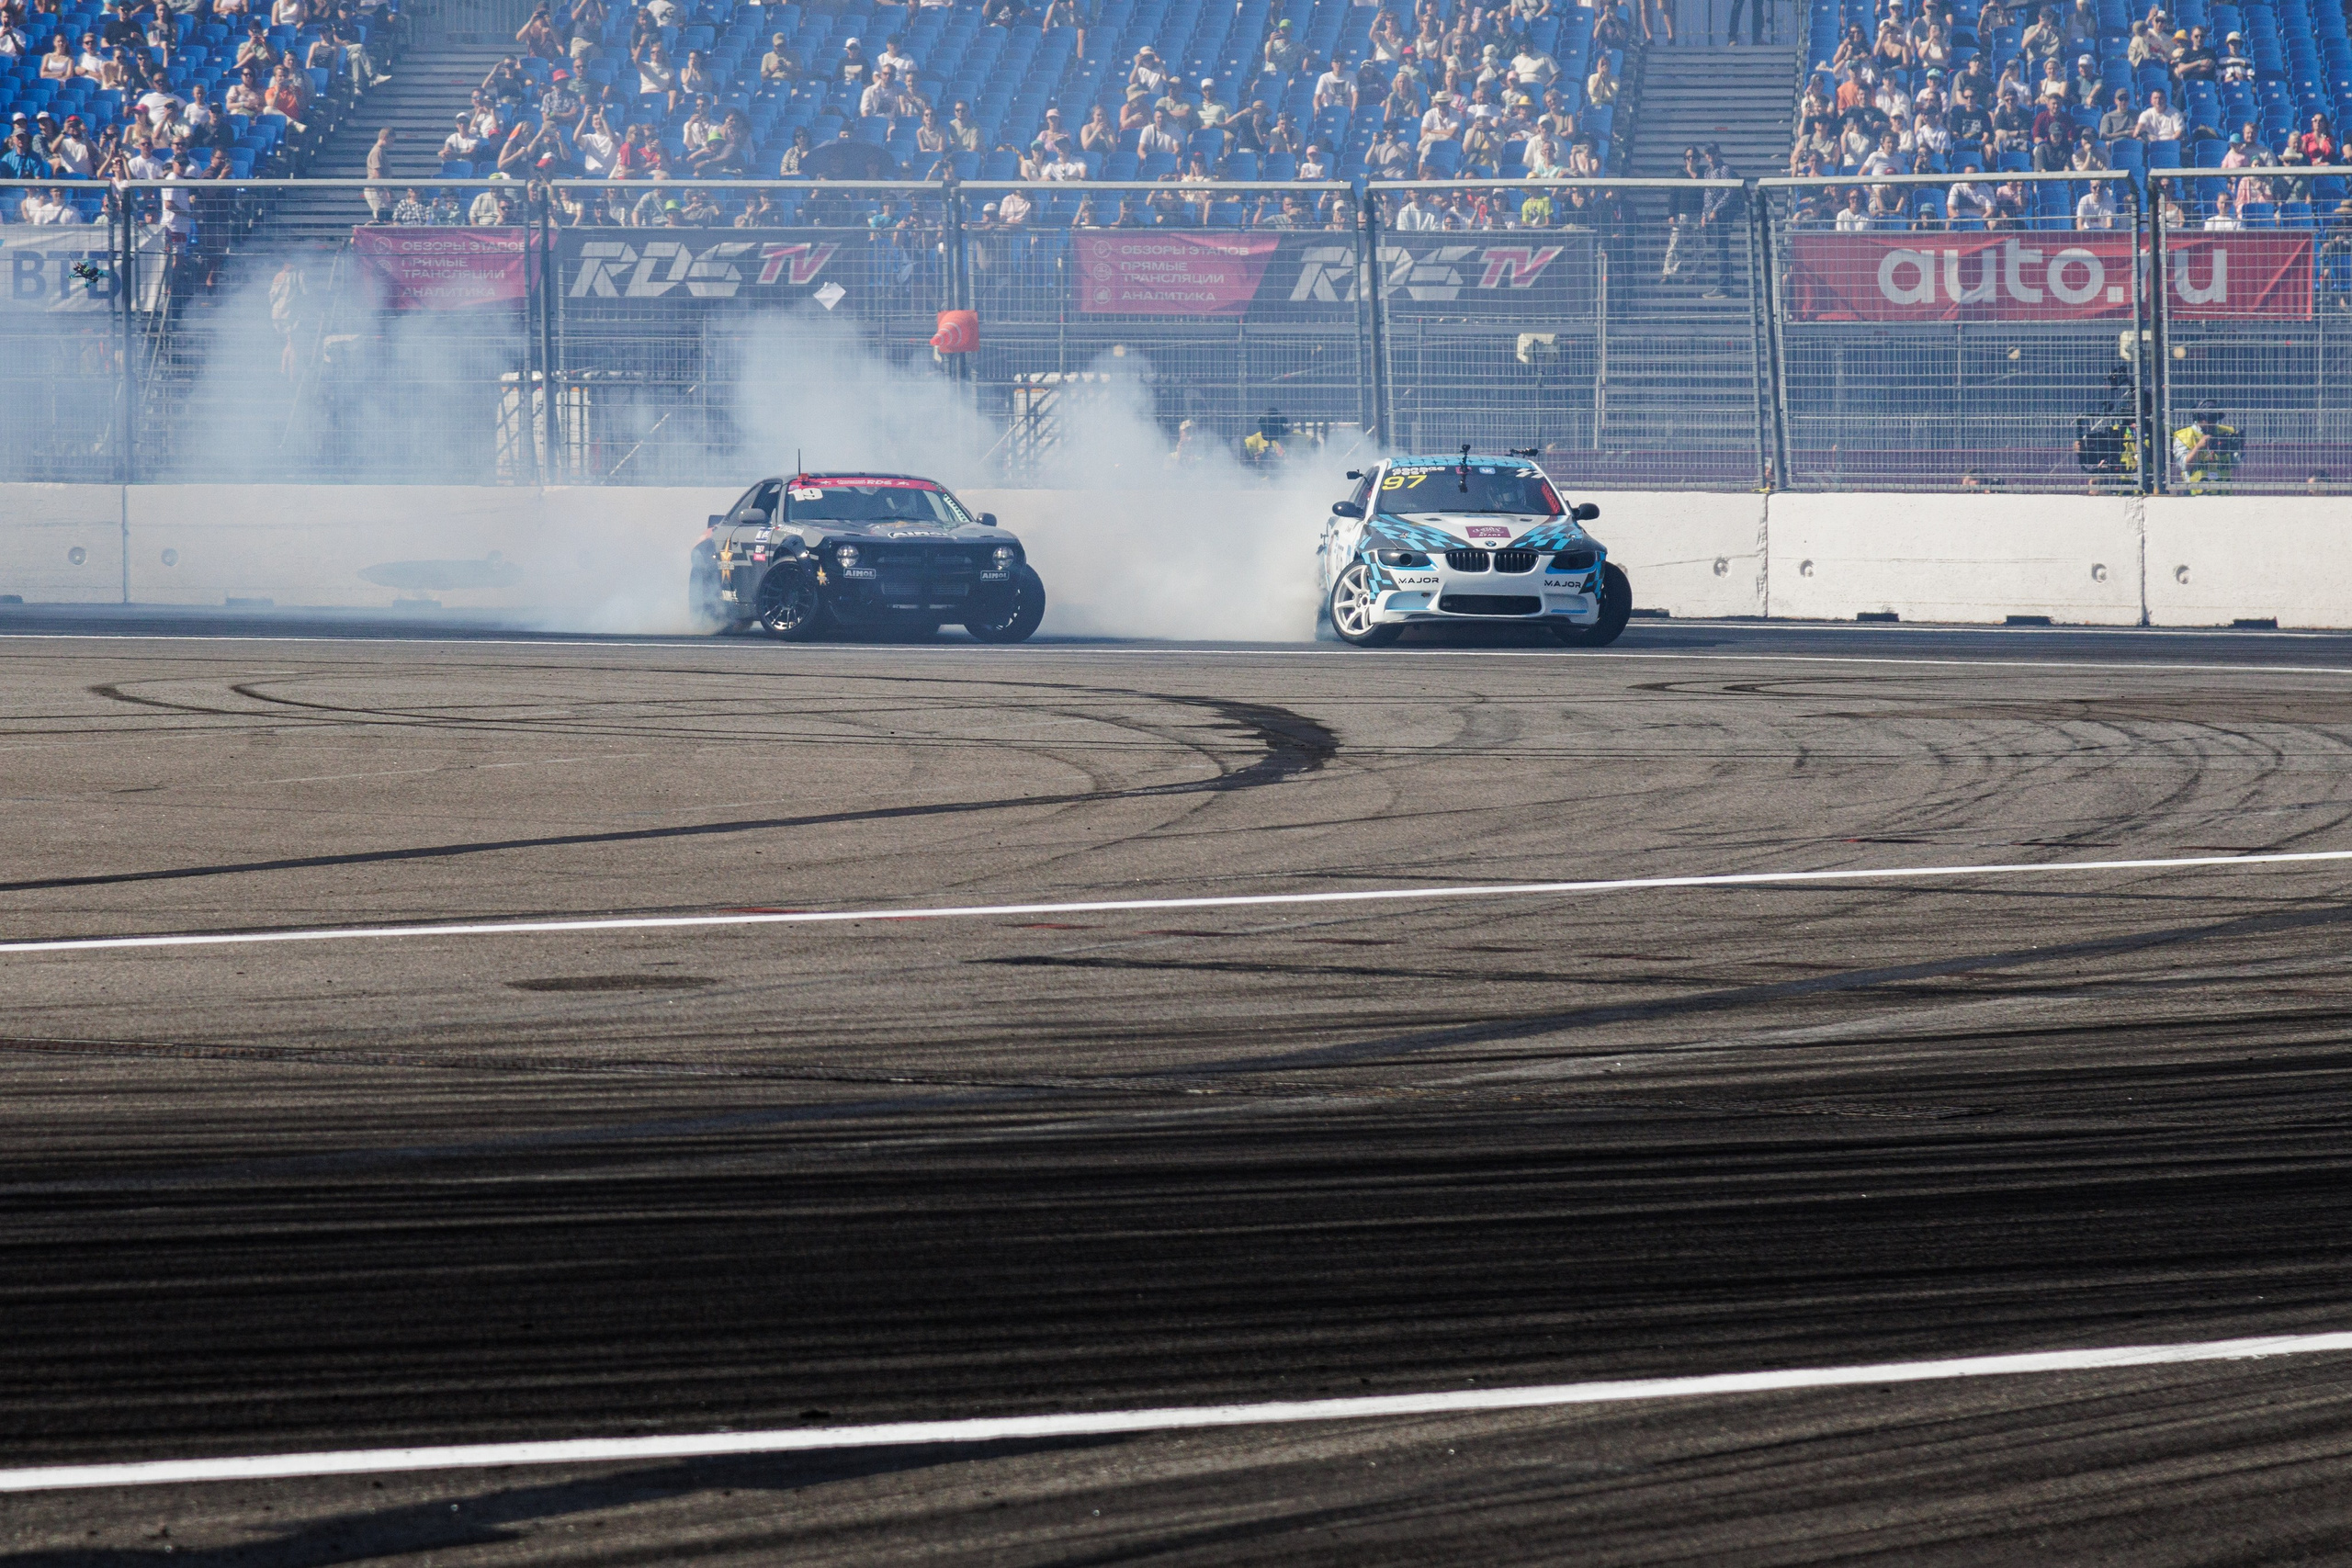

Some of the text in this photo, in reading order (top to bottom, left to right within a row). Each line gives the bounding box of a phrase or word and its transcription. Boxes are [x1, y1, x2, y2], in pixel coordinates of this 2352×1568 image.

[401, 241, 467, 252] ОБЗОРЫ
[1120, 244, 1250, 256] ОБЗОРЫ ЭТАПОВ
[401, 257, 469, 268] ПРЯМЫЕ
[1120, 261, 1189, 272] ПРЯМЫЕ
[12, 250, 122, 300] ВТБ
[401, 269, 505, 280] ТРАНСЛЯЦИИ
[568, 242, 842, 298] RDS TV
[1288, 245, 1565, 301] RDS TV
[1122, 273, 1225, 285] ТРАНСЛЯЦИИ
[402, 287, 496, 298] АНАЛИТИКА
[1121, 290, 1216, 301] АНАЛИТИКА
[1382, 475, 1428, 491] 97
[787, 487, 824, 502] 19
[844, 569, 874, 578] AIMOL
[1544, 580, 1581, 588] MAJOR
